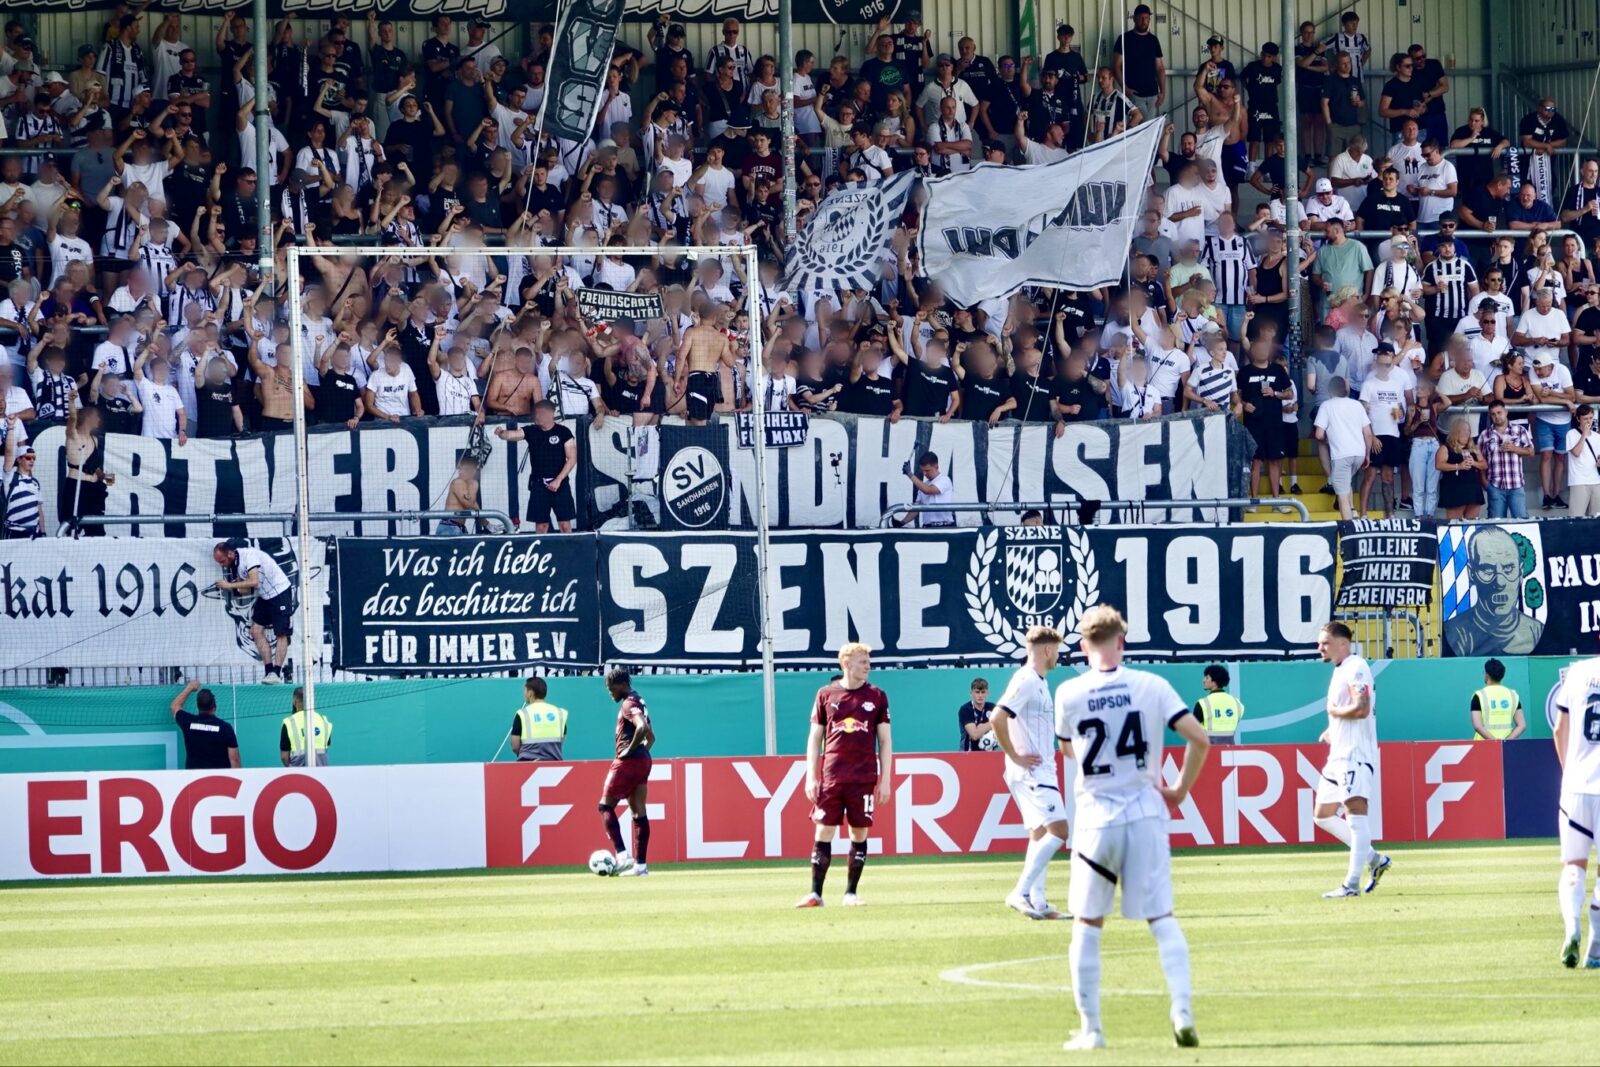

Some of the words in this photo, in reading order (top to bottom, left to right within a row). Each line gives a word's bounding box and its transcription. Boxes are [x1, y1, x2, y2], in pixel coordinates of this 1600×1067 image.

[859, 1, 886, 20] 1916
[1512, 176, 1521, 189] SV
[580, 291, 658, 308] FREUNDSCHAFT
[672, 454, 705, 490] SV
[676, 481, 719, 509] SANDHAUSEN
[693, 502, 711, 517] 1916
[1005, 526, 1062, 540] SZENE
[1352, 519, 1421, 533] NIEMALS
[1358, 538, 1419, 557] ALLEINE
[382, 548, 441, 577] Was
[448, 541, 486, 577] ich
[493, 540, 556, 578] liebe,
[1361, 563, 1411, 581] IMMER
[91, 562, 198, 618] 1916
[362, 583, 411, 616] das
[415, 582, 533, 616] beschütze
[540, 579, 578, 613] ich
[608, 541, 951, 655] SZENE
[1114, 534, 1334, 646] 1916
[1338, 587, 1427, 606] GEMEINSAM
[1016, 615, 1054, 629] 1916
[364, 630, 418, 664] FÜR
[428, 633, 516, 664] IMMER
[525, 632, 578, 660] E.V.
[1087, 694, 1132, 712] GIPSON
[1077, 711, 1149, 777] 24
[27, 773, 338, 875] ERGO
